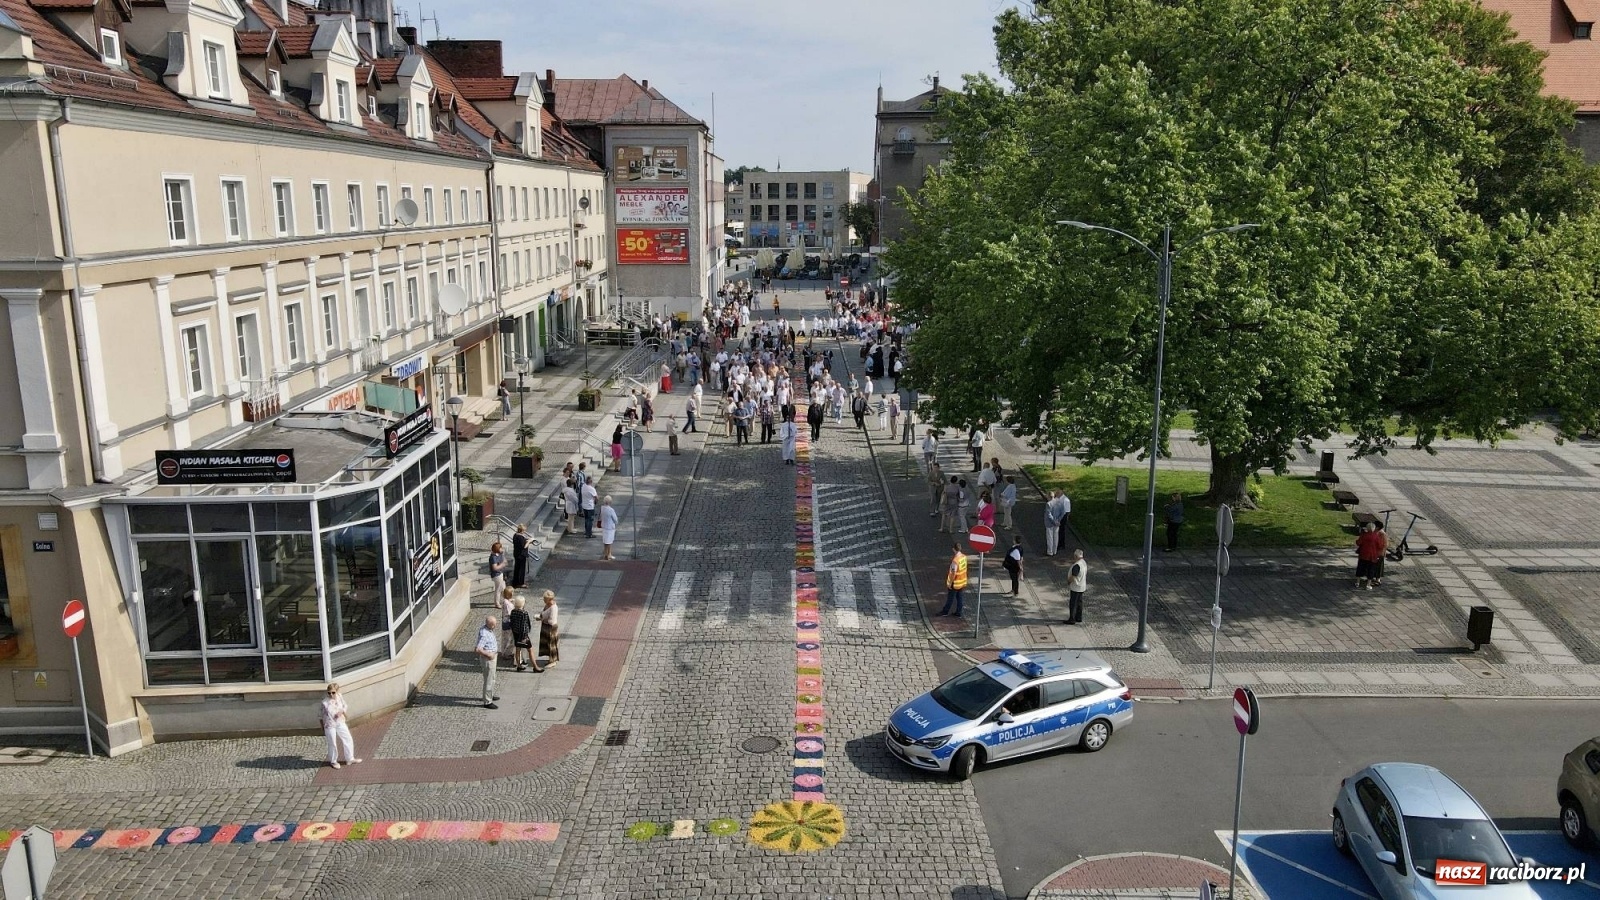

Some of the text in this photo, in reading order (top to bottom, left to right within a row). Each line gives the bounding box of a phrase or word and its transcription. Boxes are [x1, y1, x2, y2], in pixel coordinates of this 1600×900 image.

[620, 194, 686, 202] ALEXANDER
[328, 386, 360, 411] APTEKA
[179, 455, 276, 466] INDIAN MASALA KITCHEN
[903, 707, 931, 729] POLICJA
[998, 724, 1036, 742] POLICJA
